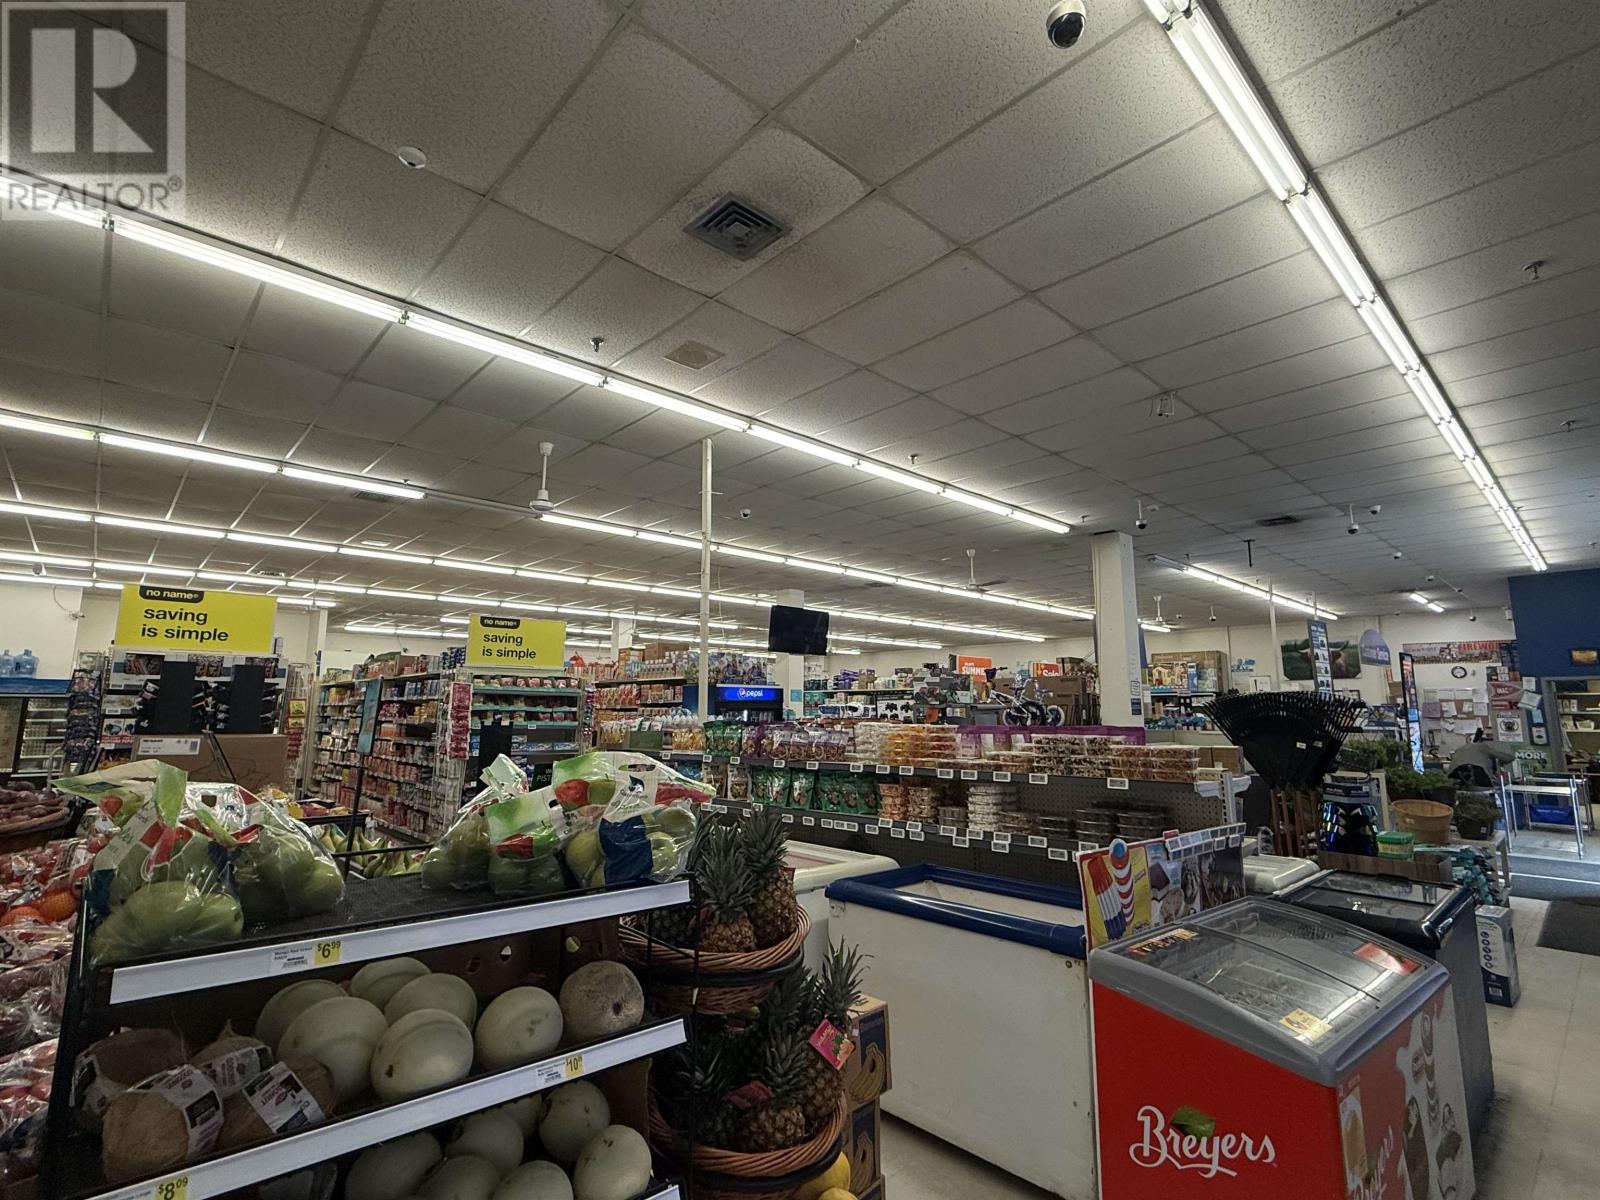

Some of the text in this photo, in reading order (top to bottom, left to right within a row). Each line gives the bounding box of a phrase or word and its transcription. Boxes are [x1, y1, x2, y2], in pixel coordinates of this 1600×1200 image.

[146, 588, 161, 597] no
[144, 608, 208, 625] saving
[141, 624, 229, 643] is simple
[483, 633, 523, 647] saving
[482, 645, 536, 660] is simple
[1129, 1105, 1276, 1178] Breyers
